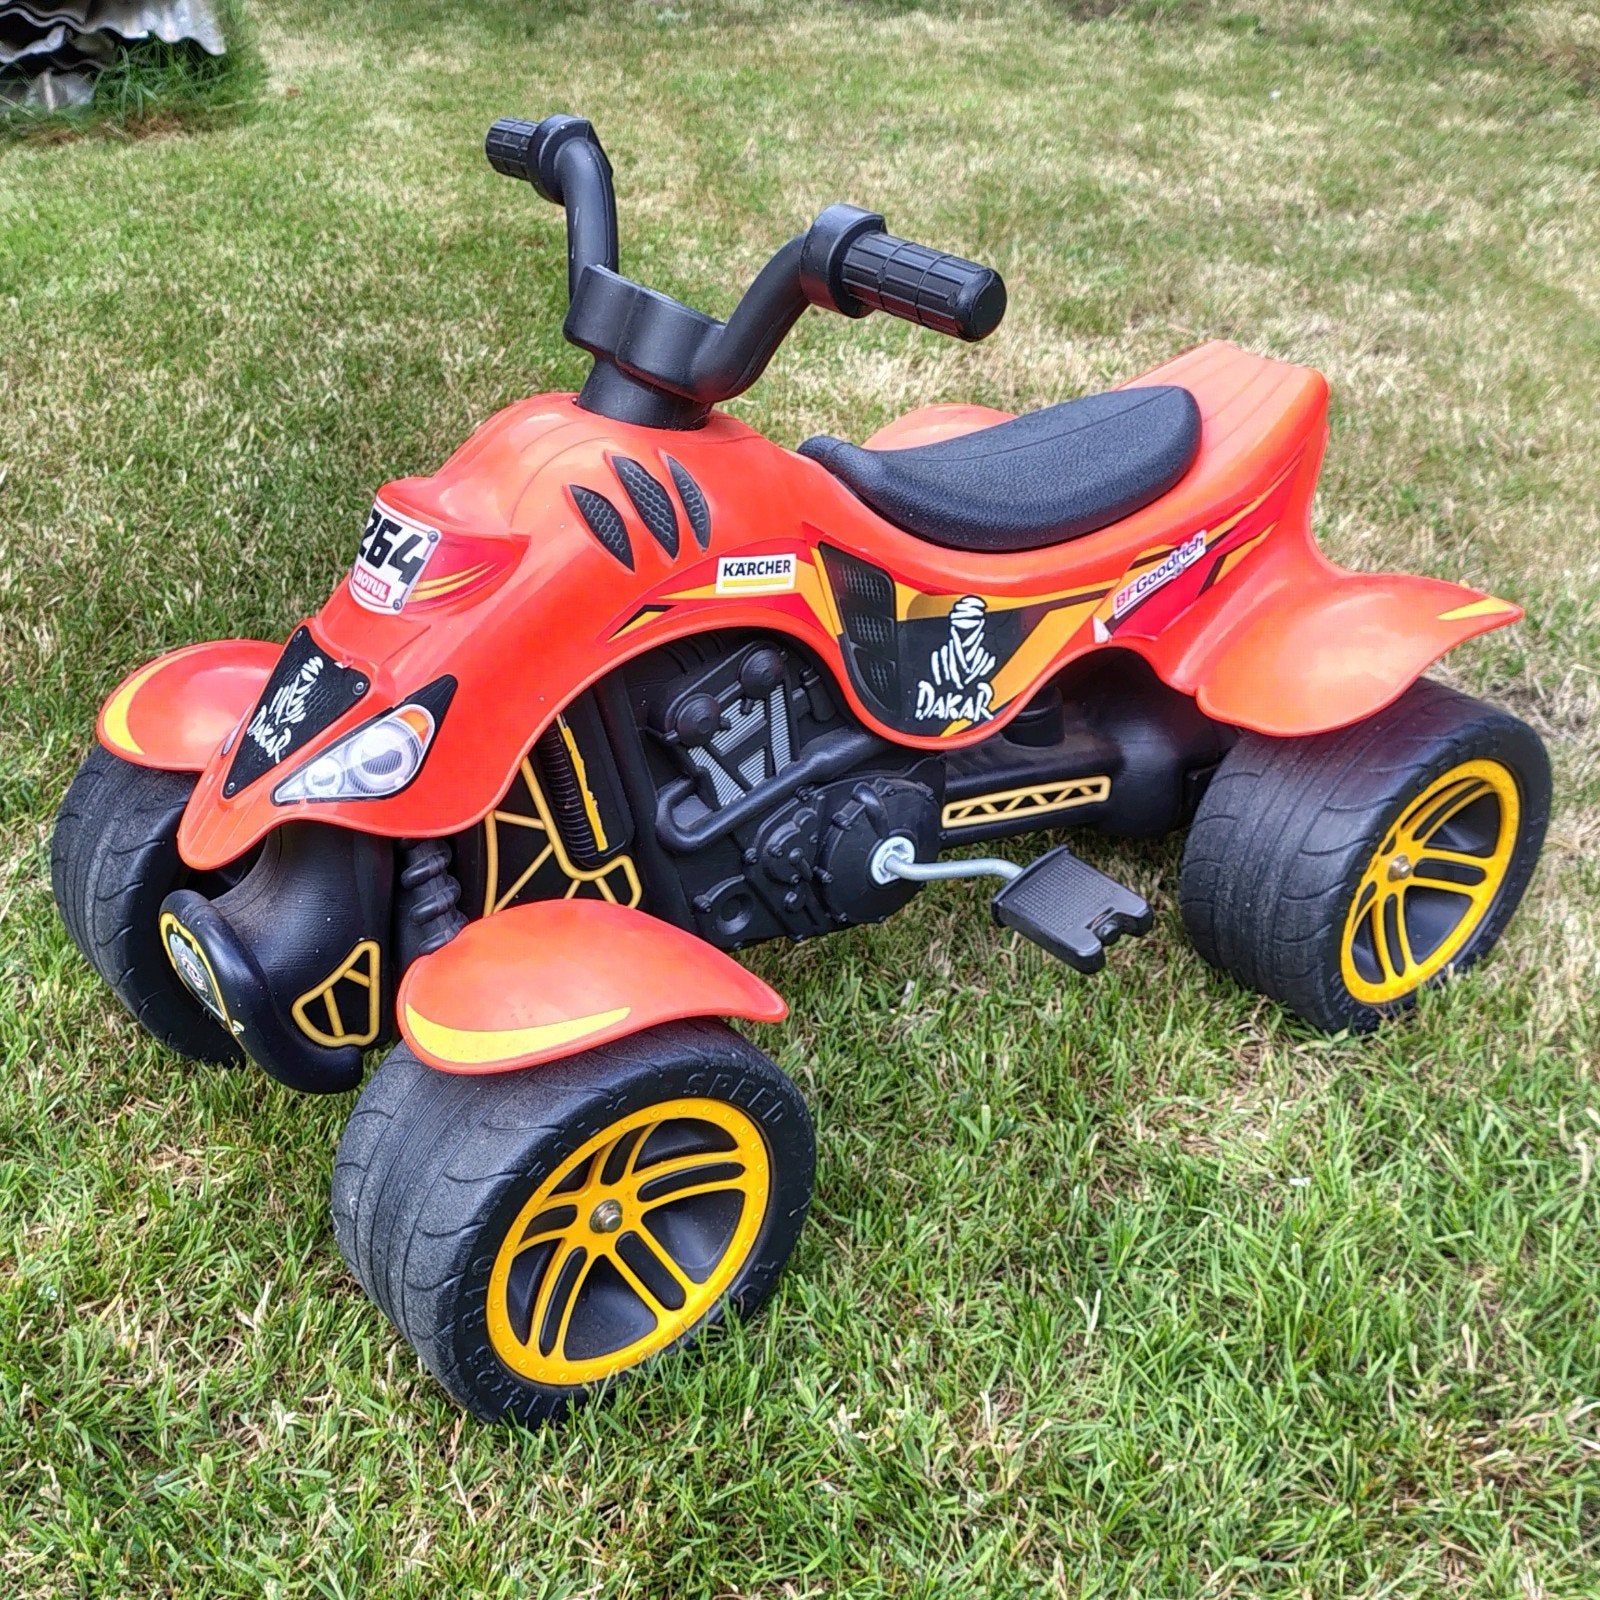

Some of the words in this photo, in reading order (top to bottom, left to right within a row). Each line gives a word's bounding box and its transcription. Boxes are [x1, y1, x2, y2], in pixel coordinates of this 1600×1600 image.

[358, 508, 426, 586] 264
[723, 560, 791, 577] KÄRCHER
[1116, 537, 1204, 609] BFGoodrich
[355, 568, 388, 602] MOTUL
[915, 680, 994, 722] DAKAR
[246, 705, 292, 764] DAKAR
[682, 1073, 789, 1126] SPEED
